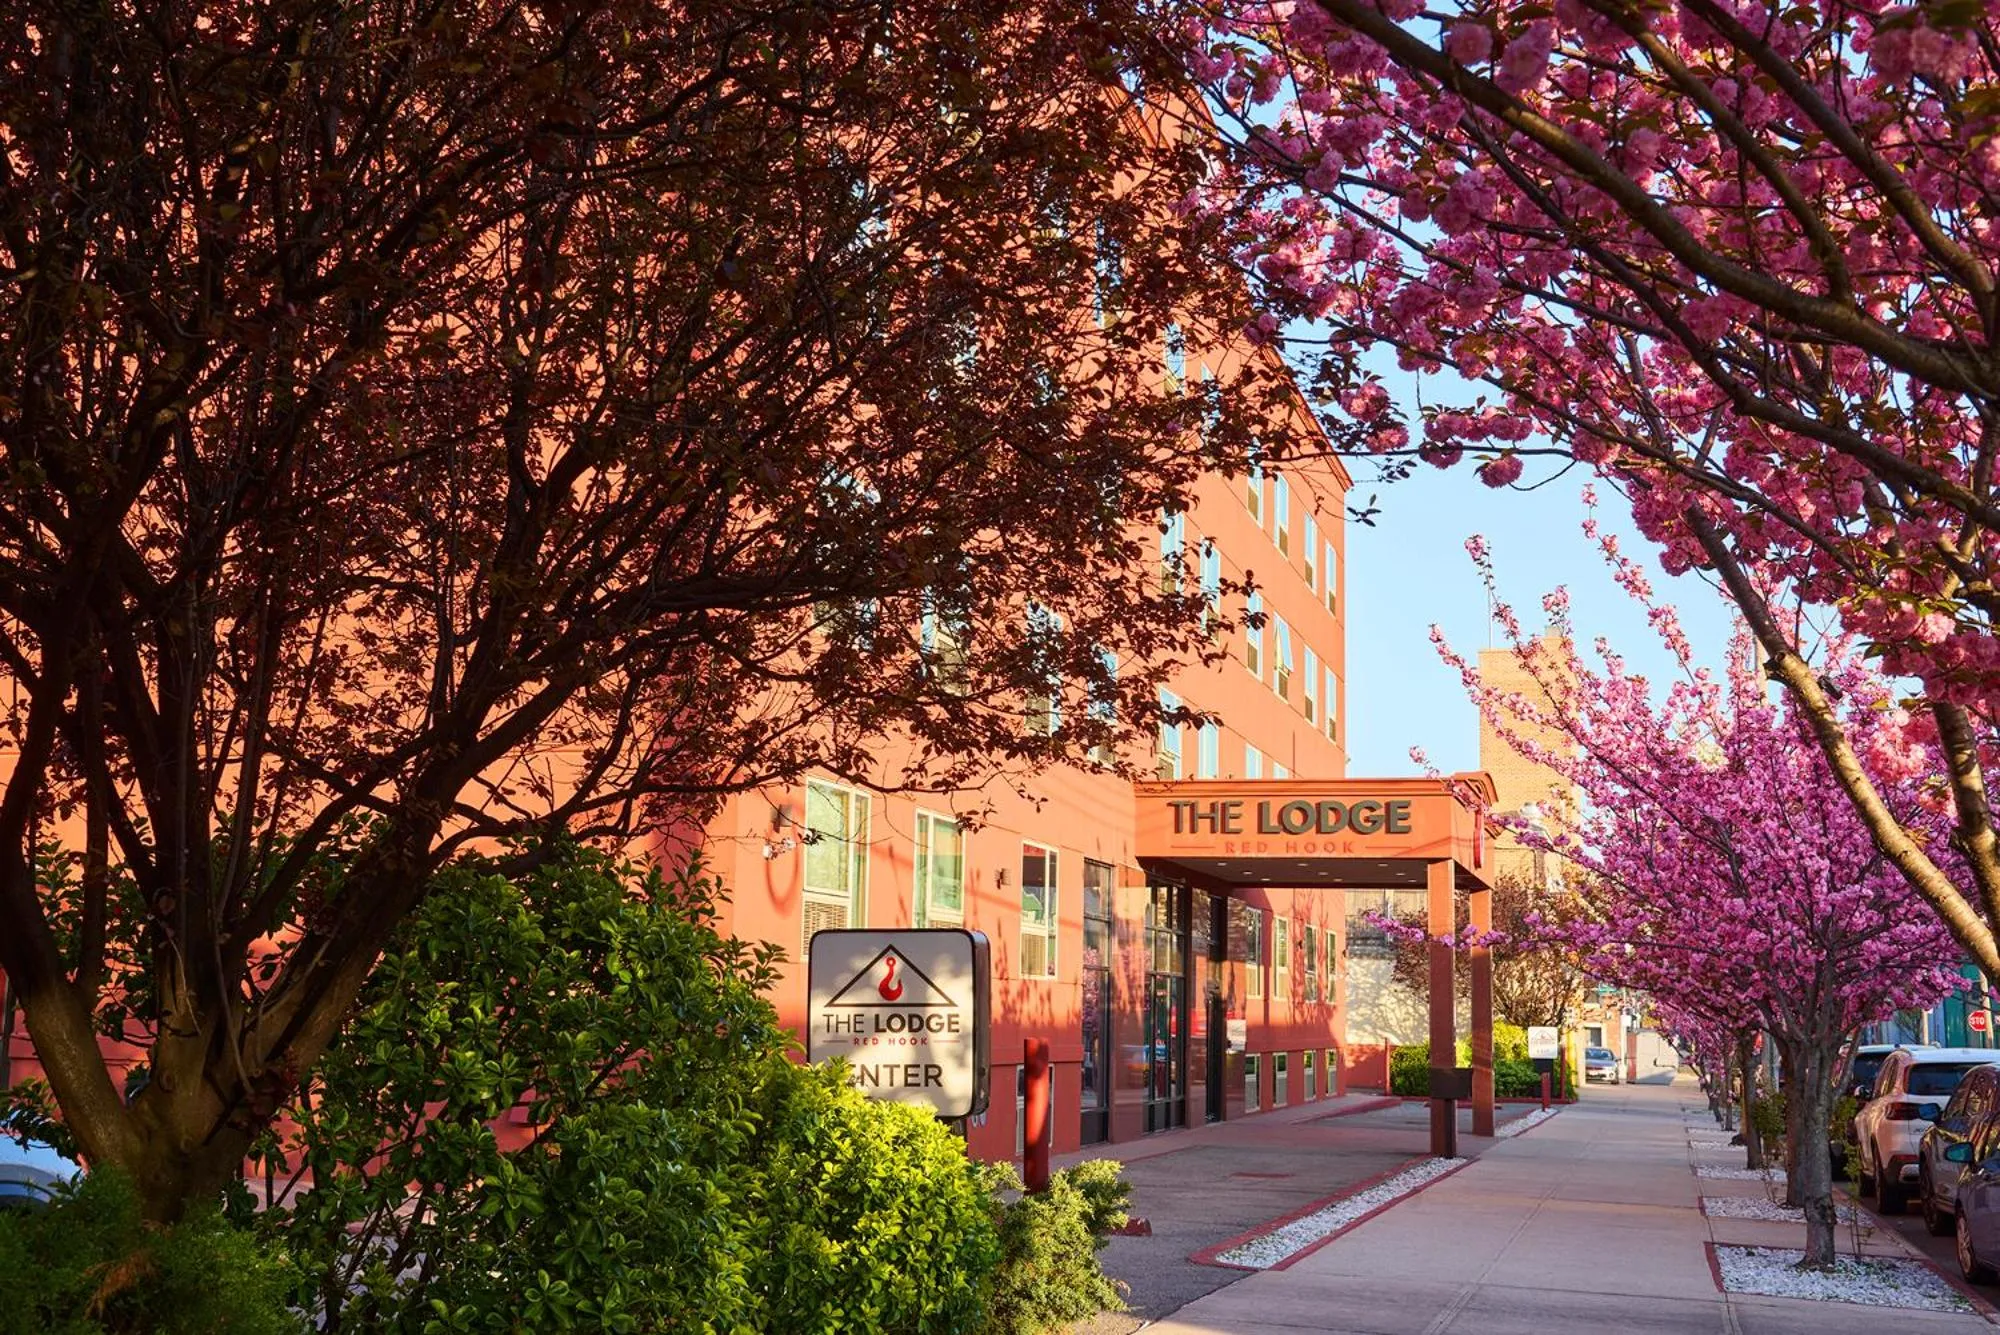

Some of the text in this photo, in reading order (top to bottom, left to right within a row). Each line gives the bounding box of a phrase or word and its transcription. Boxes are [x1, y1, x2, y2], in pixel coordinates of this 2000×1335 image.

[1167, 799, 1412, 835] THE LODGE
[1225, 841, 1354, 853] RED HOOK
[823, 1013, 960, 1033] THE LODGE
[853, 1037, 929, 1046] RED HOOK
